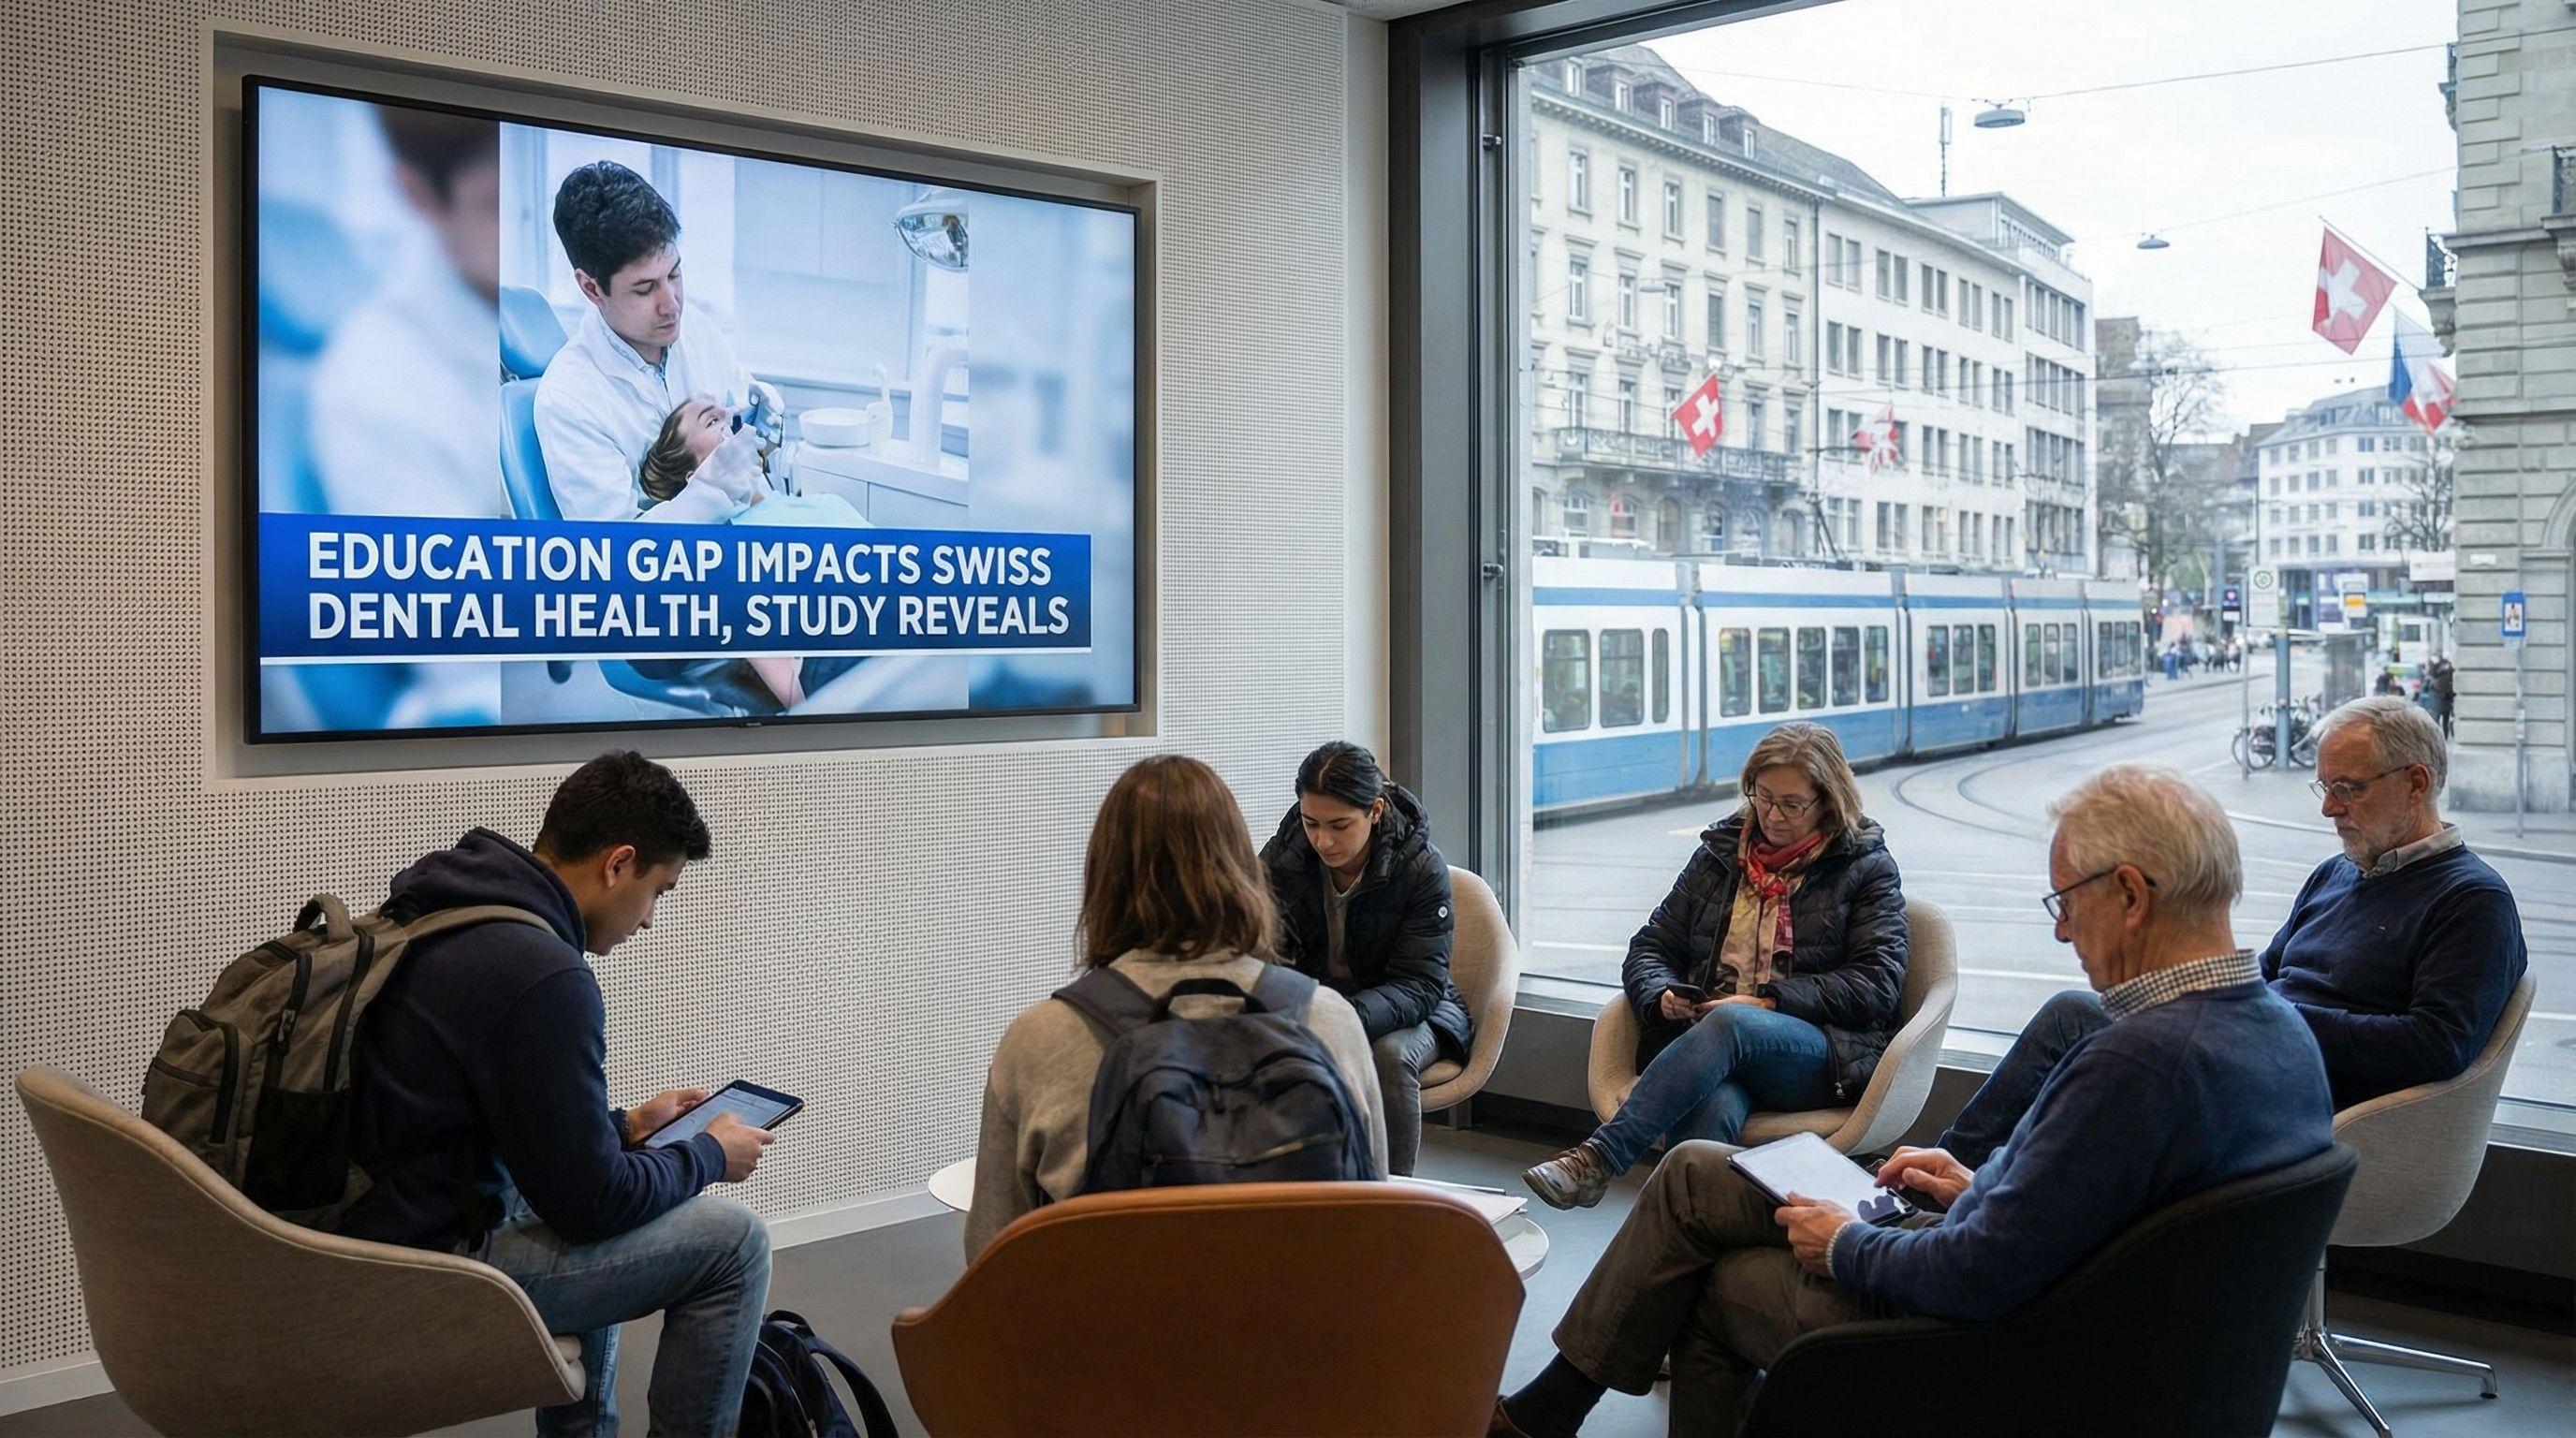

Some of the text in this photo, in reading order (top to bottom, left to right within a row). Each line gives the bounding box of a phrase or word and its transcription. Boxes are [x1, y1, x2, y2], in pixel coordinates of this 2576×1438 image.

[309, 532, 1051, 586] EDUCATION GAP IMPACTS SWISS
[309, 593, 1069, 645] DENTAL HEALTH, STUDY REVEALS
